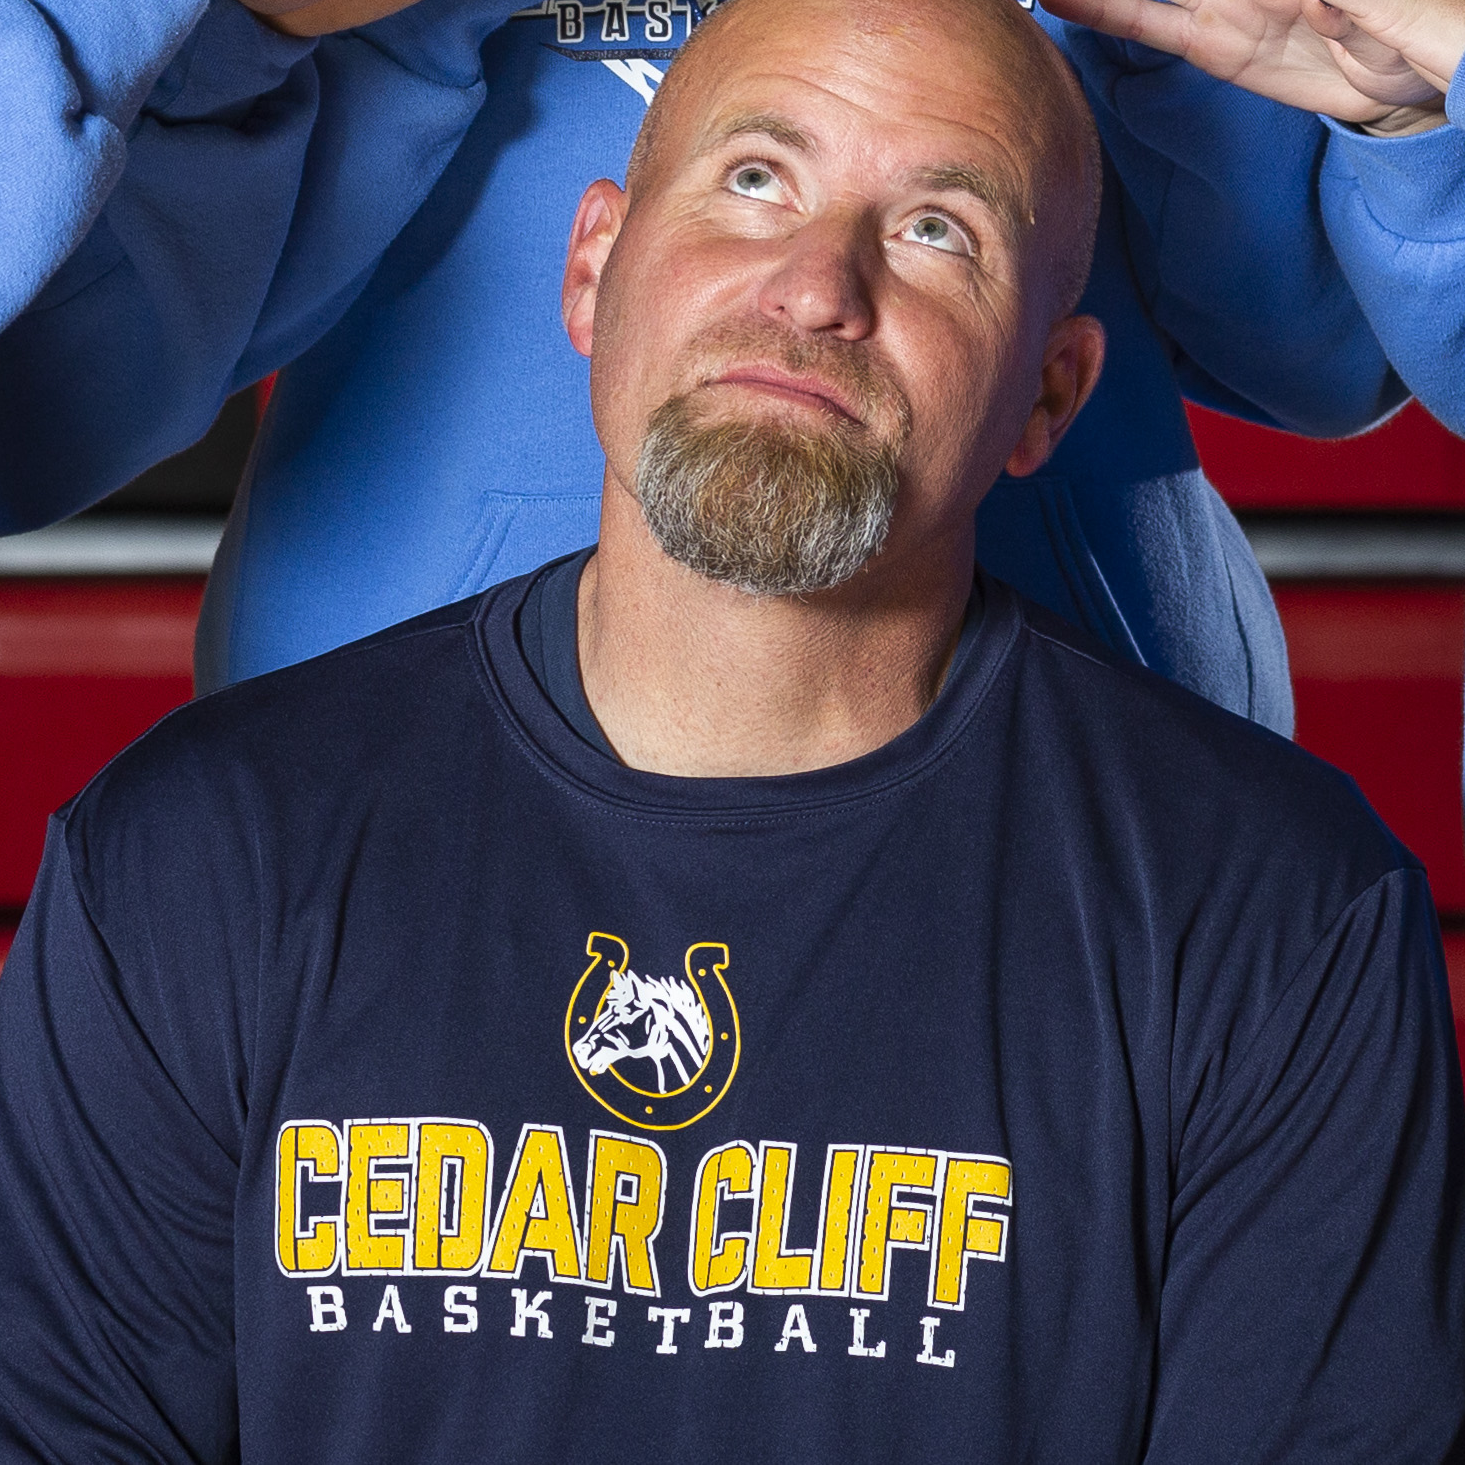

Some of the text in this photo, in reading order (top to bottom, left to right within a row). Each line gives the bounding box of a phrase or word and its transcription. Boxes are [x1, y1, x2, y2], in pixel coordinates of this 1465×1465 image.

[275, 1116, 1014, 1312] CEDAR CLIFF
[309, 1283, 957, 1368] BASKETBALL
